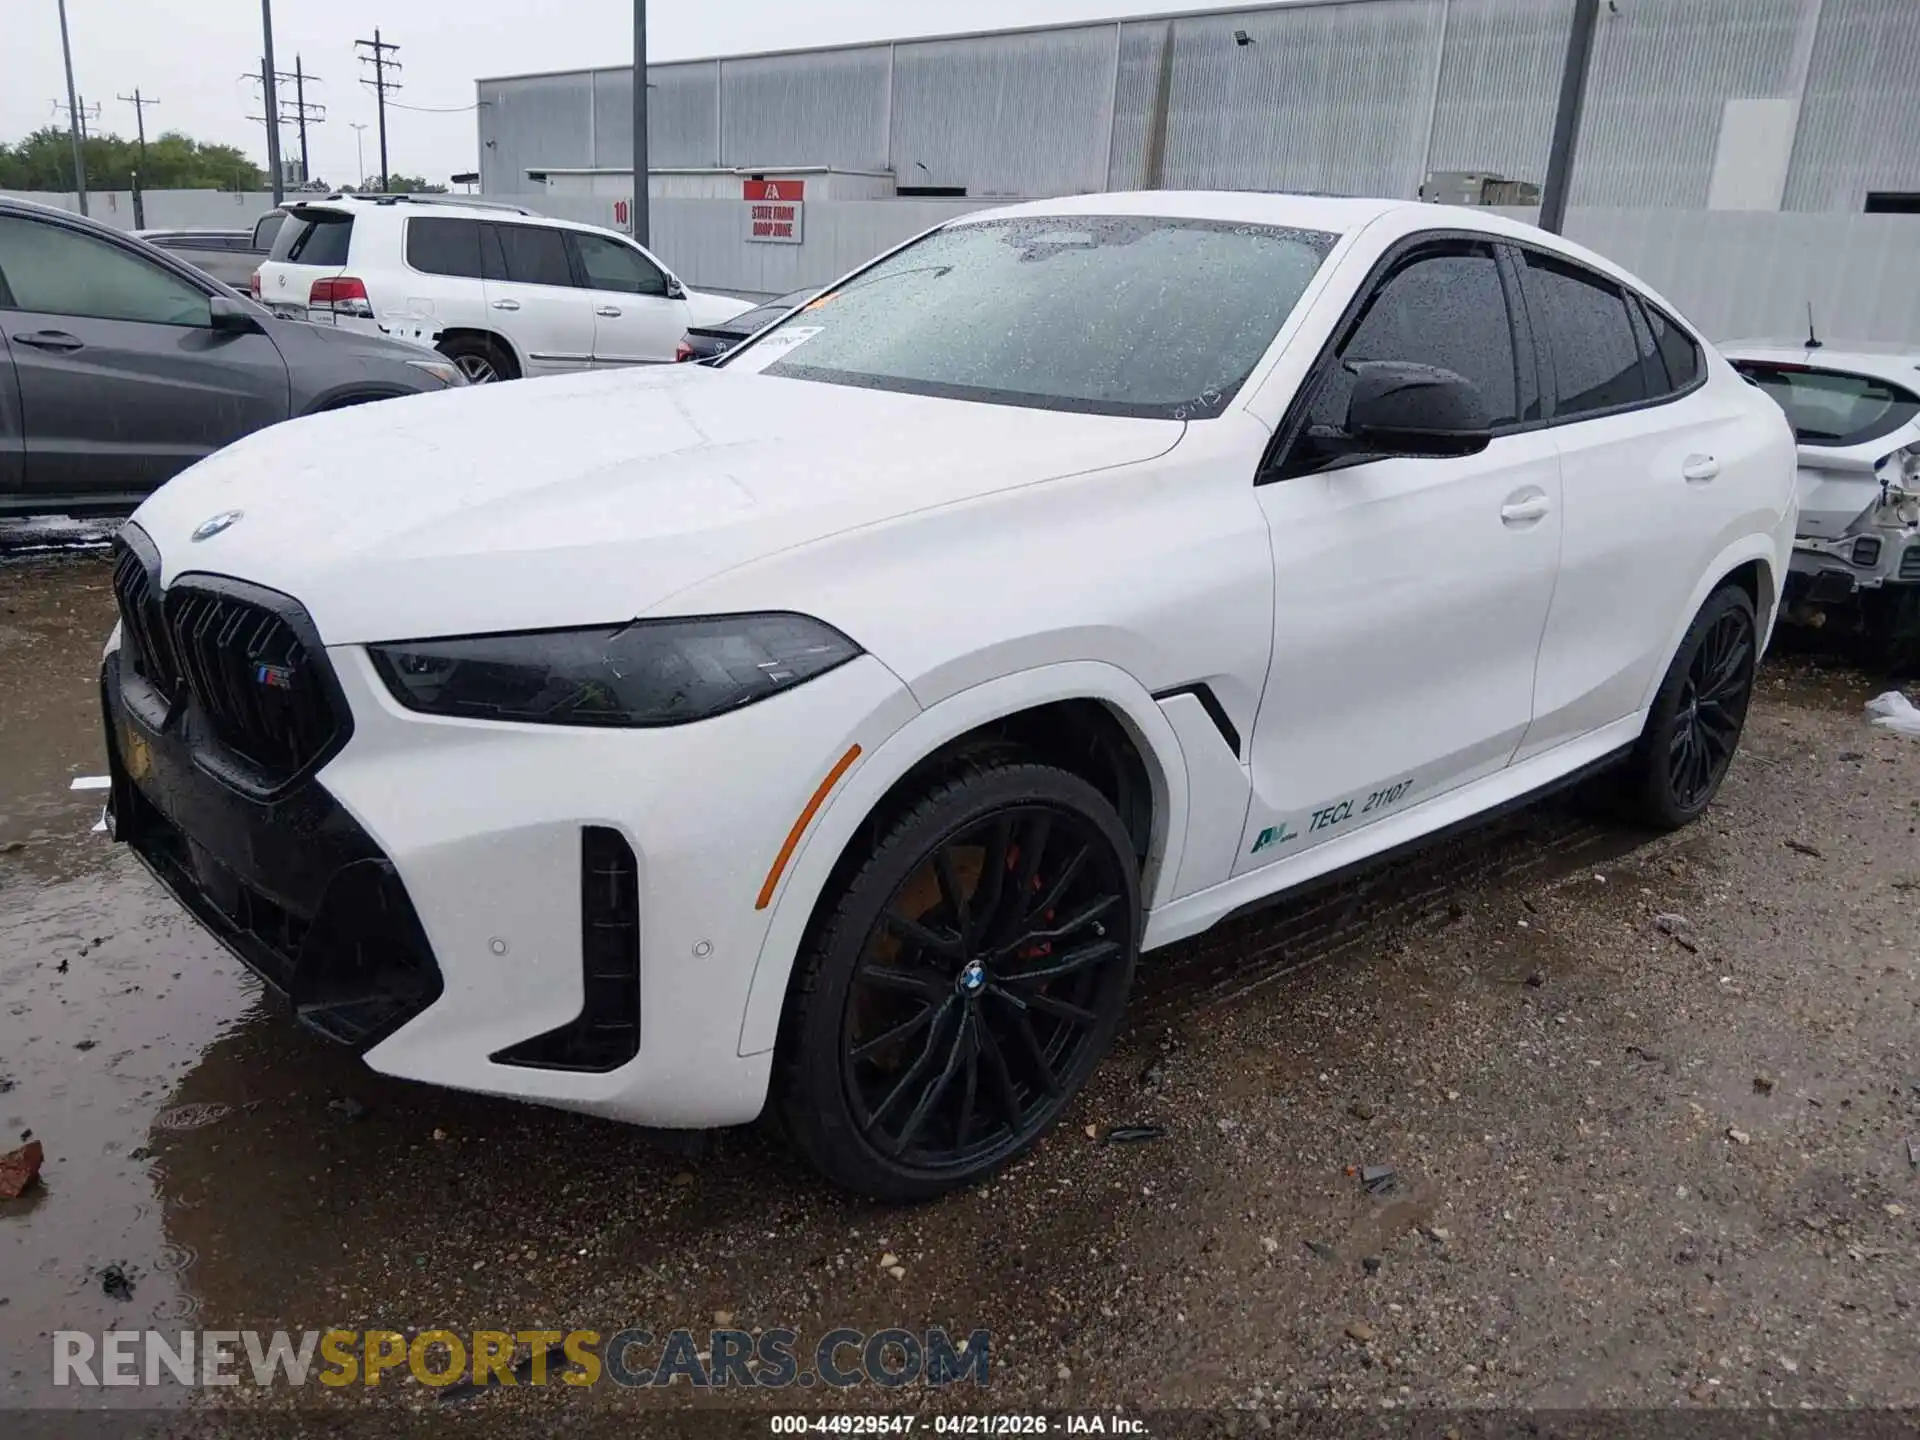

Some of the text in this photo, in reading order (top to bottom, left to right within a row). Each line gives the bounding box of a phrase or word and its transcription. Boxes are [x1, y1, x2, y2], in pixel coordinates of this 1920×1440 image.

[614, 201, 627, 224] 10
[752, 206, 794, 221] STATE FARM
[753, 222, 793, 237] DROP ZONE
[1308, 800, 1354, 833] TECL
[1361, 779, 1414, 813] 21107
